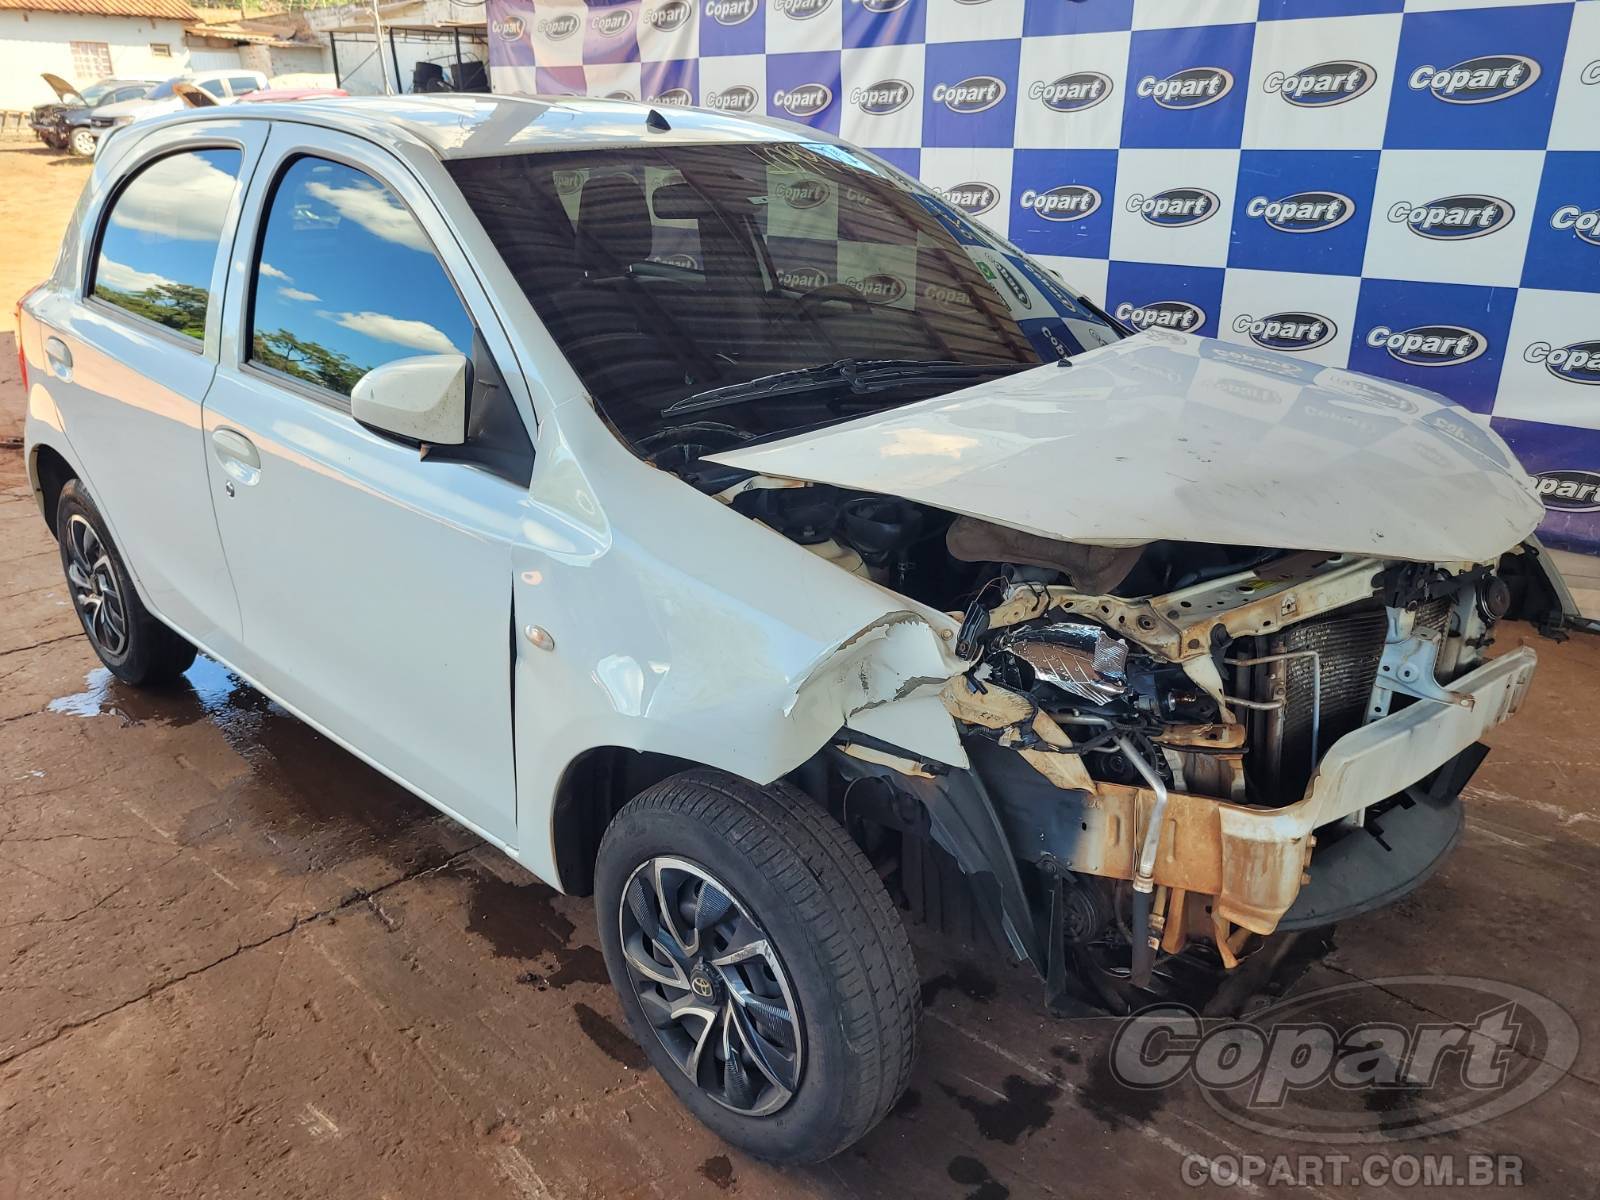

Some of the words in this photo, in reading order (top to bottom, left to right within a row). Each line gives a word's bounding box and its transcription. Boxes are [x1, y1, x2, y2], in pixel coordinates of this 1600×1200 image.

[591, 11, 628, 31] Copart
[643, 5, 685, 23] Copart
[705, 0, 750, 19] Copart
[538, 17, 575, 33] Copart
[1028, 77, 1101, 103] Copart
[1137, 71, 1223, 103] Copart
[1263, 67, 1363, 98] Copart
[1408, 61, 1525, 94] Copart
[707, 91, 750, 109] Copart
[773, 87, 822, 107] Copart
[850, 84, 905, 105] Copart
[932, 81, 996, 105] Copart
[1020, 189, 1093, 213] Copart
[1126, 193, 1208, 217] Copart
[1246, 196, 1341, 223] Copart
[1387, 201, 1498, 229] Copart
[1114, 302, 1193, 332] Copart
[1231, 314, 1324, 342] Copart
[1366, 324, 1472, 357] Copart
[1523, 341, 1600, 372] Copa
